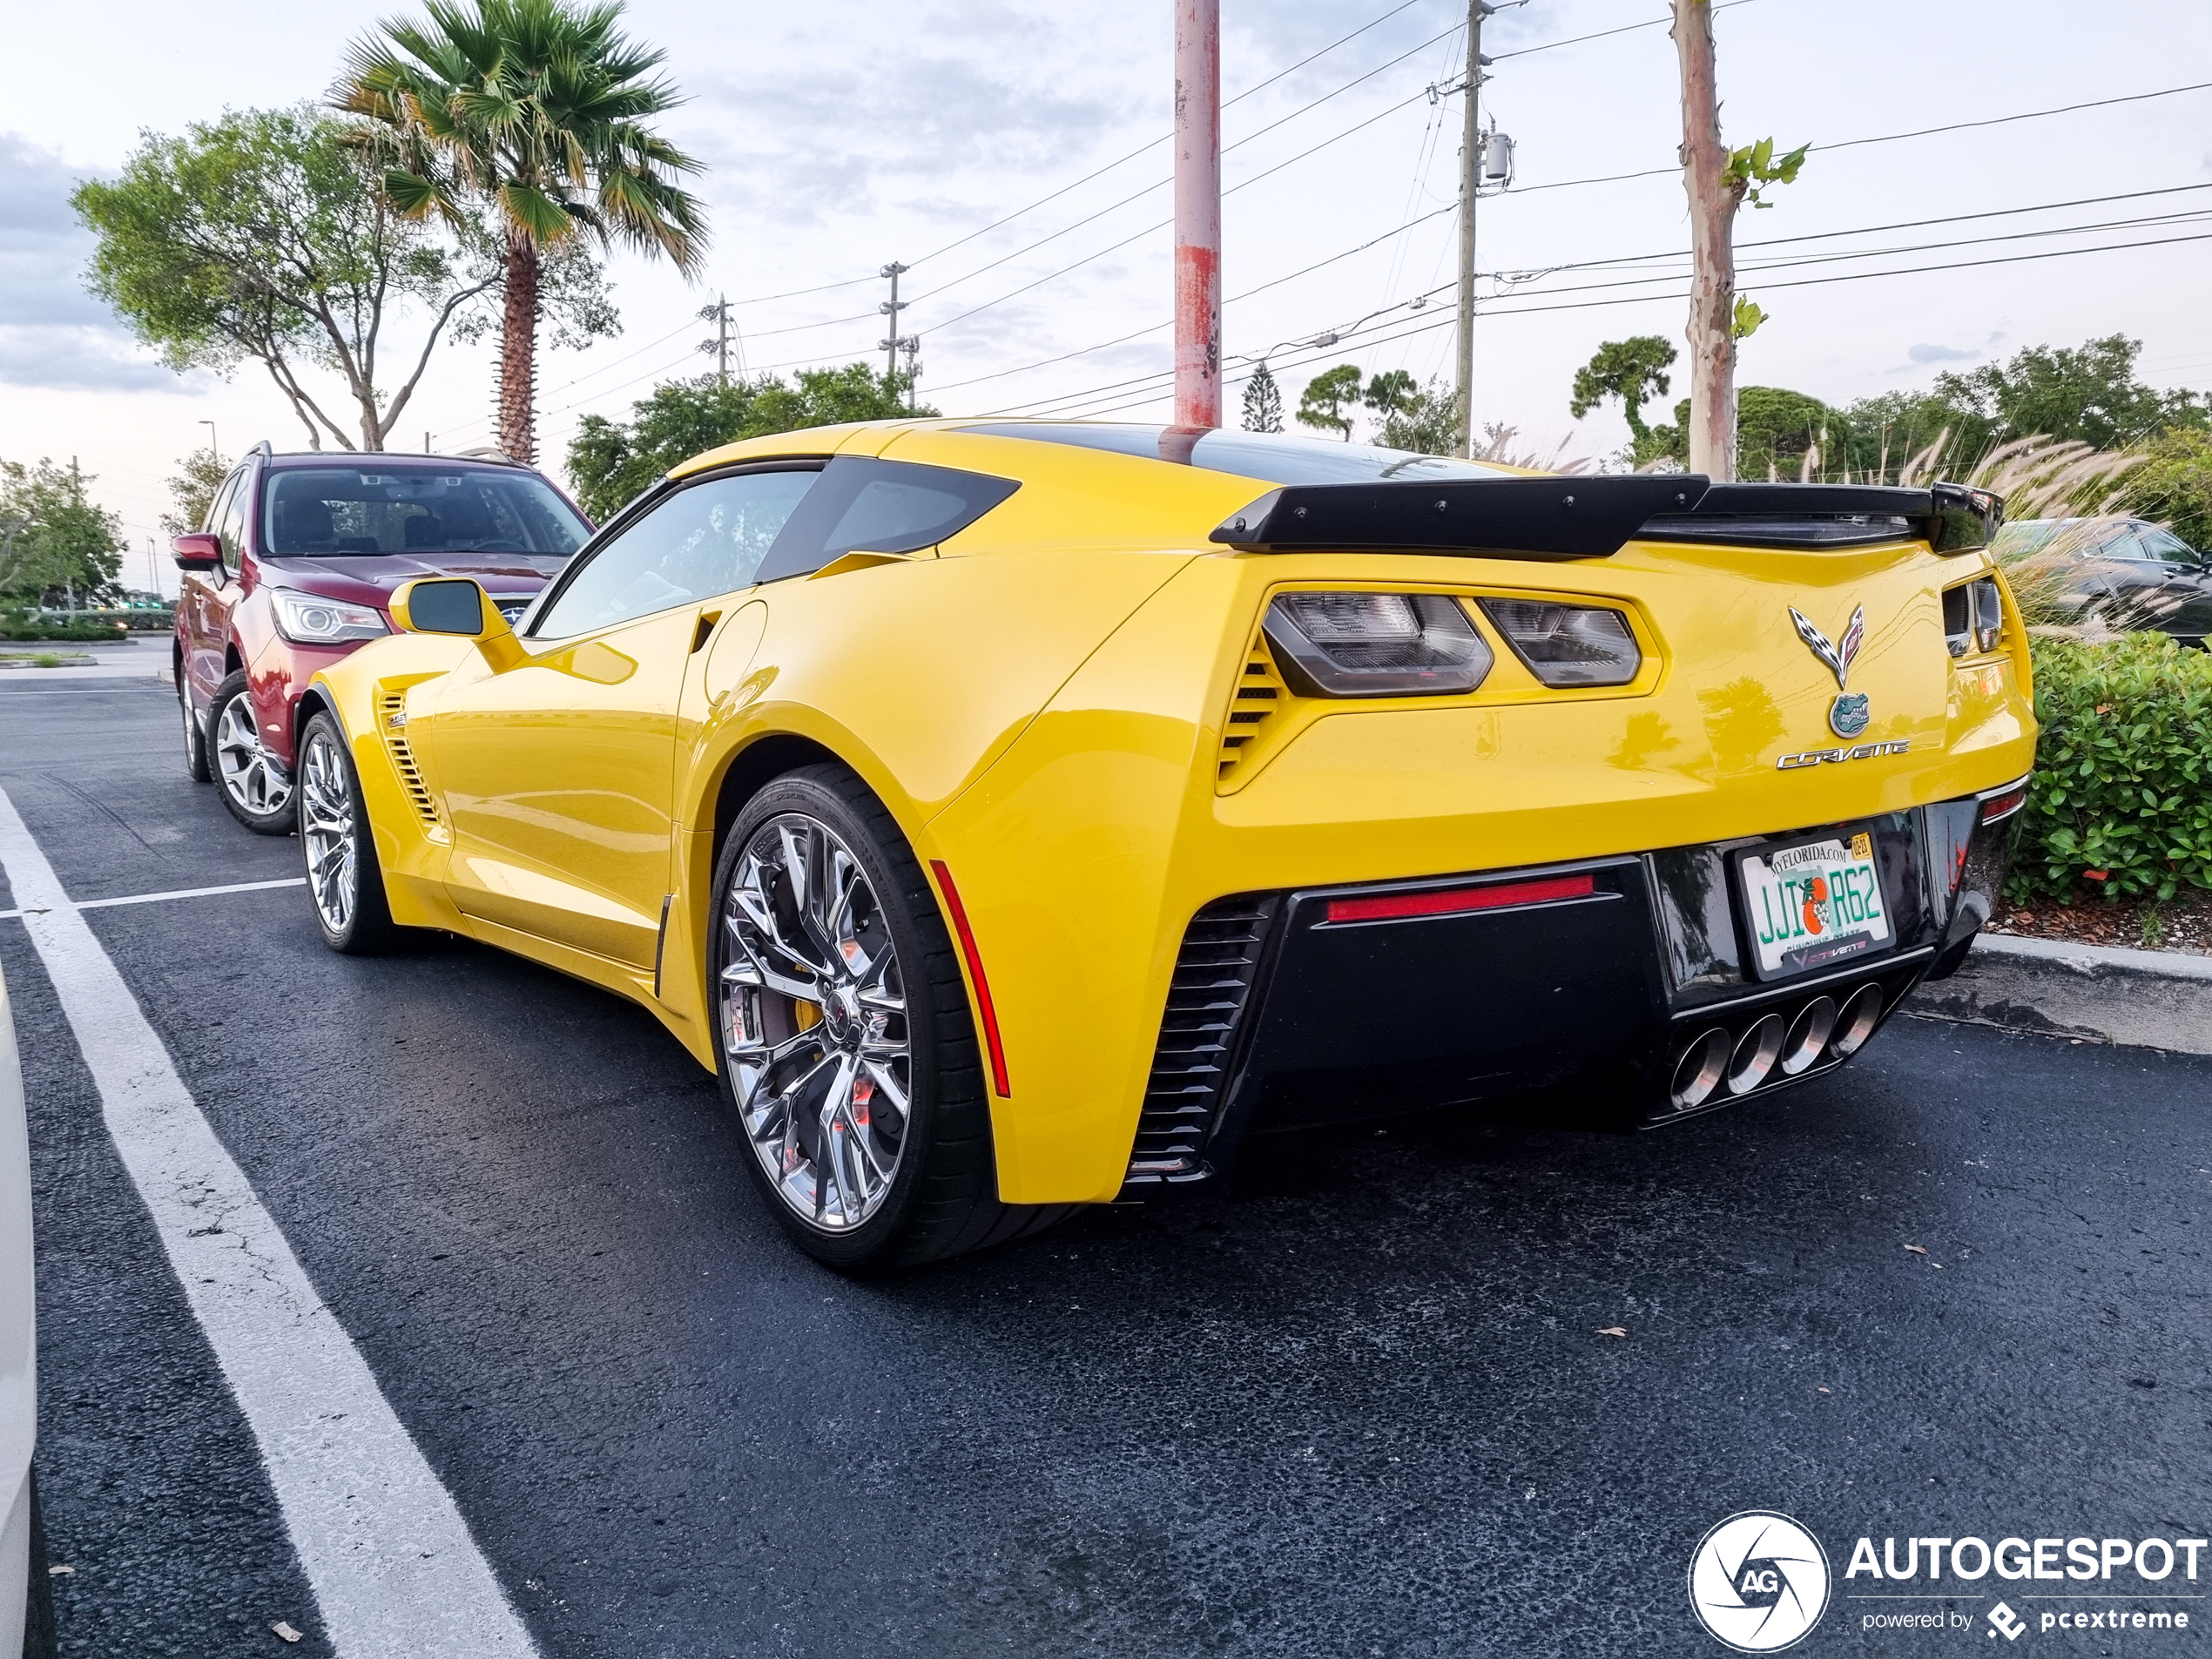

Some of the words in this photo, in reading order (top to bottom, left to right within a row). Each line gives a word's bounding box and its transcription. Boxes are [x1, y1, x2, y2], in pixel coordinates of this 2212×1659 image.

[1777, 739, 1911, 770] CORVETTE
[1771, 846, 1846, 878] MYFLORIDA.COM
[1828, 863, 1881, 927] R62
